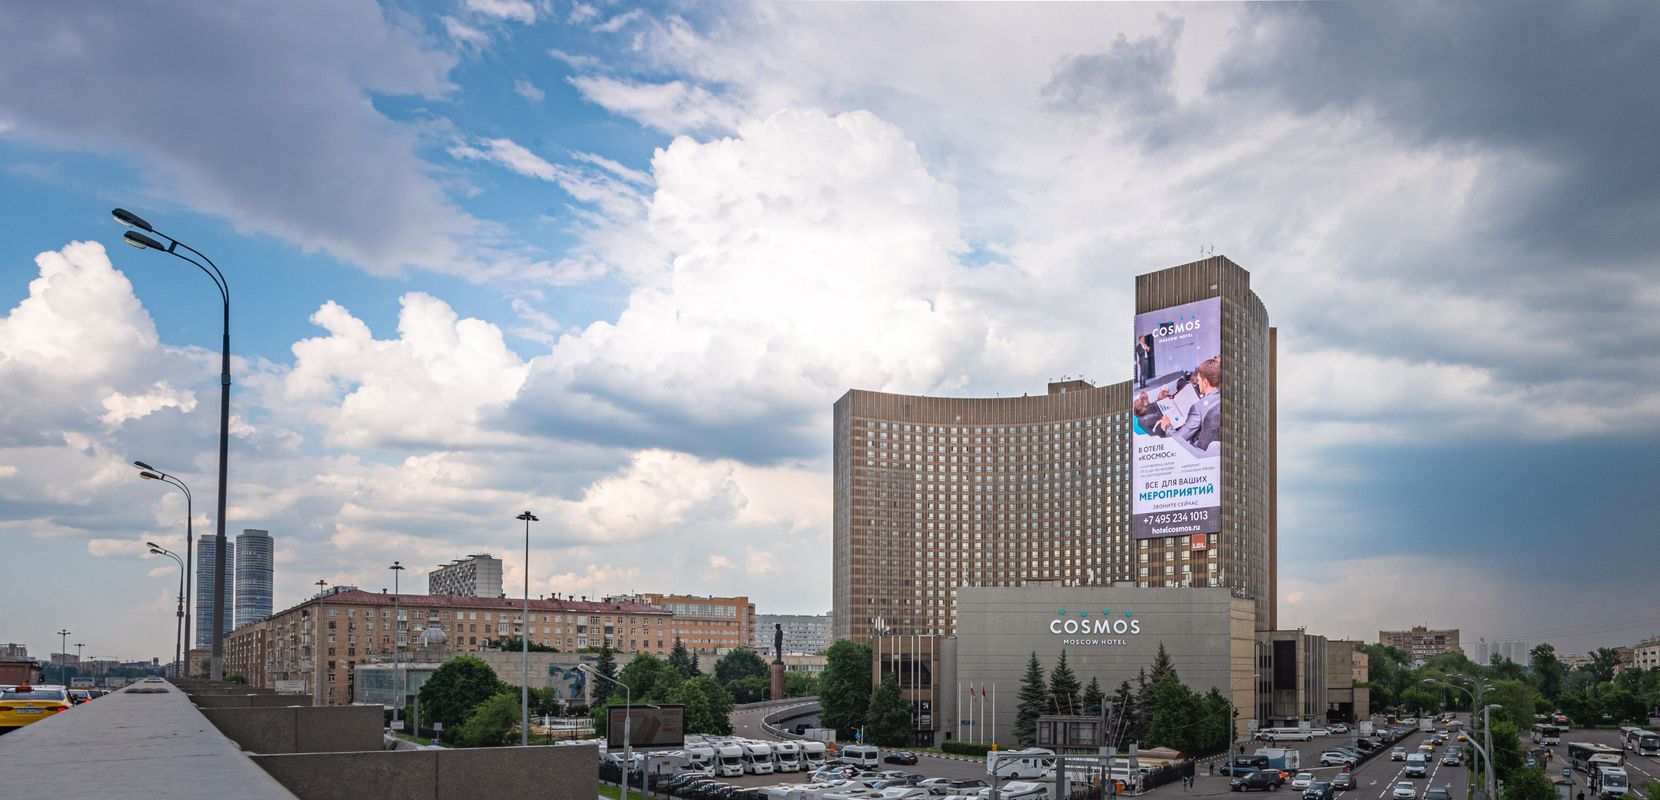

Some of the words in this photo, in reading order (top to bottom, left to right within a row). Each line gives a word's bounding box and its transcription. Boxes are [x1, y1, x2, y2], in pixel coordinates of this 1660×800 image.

[1152, 320, 1200, 337] COSMOS
[1143, 444, 1164, 453] ОТЕЛЕ
[1138, 451, 1177, 461] «КОСМОС»:
[1145, 481, 1158, 489] ВСЕ
[1161, 479, 1177, 488] ДЛЯ
[1179, 475, 1207, 486] ВАШИХ
[1139, 483, 1214, 501] МЕРОПРИЯТИЙ
[1152, 502, 1176, 510] ЗВОНИТЕ
[1177, 500, 1199, 508] СЕЙЧАС
[1143, 515, 1154, 525] +7
[1155, 513, 1171, 524] 495
[1172, 512, 1188, 523] 234
[1190, 510, 1209, 521] 1013
[1152, 525, 1200, 534] hotelcosmos.ru
[1050, 619, 1141, 634] COSMOS
